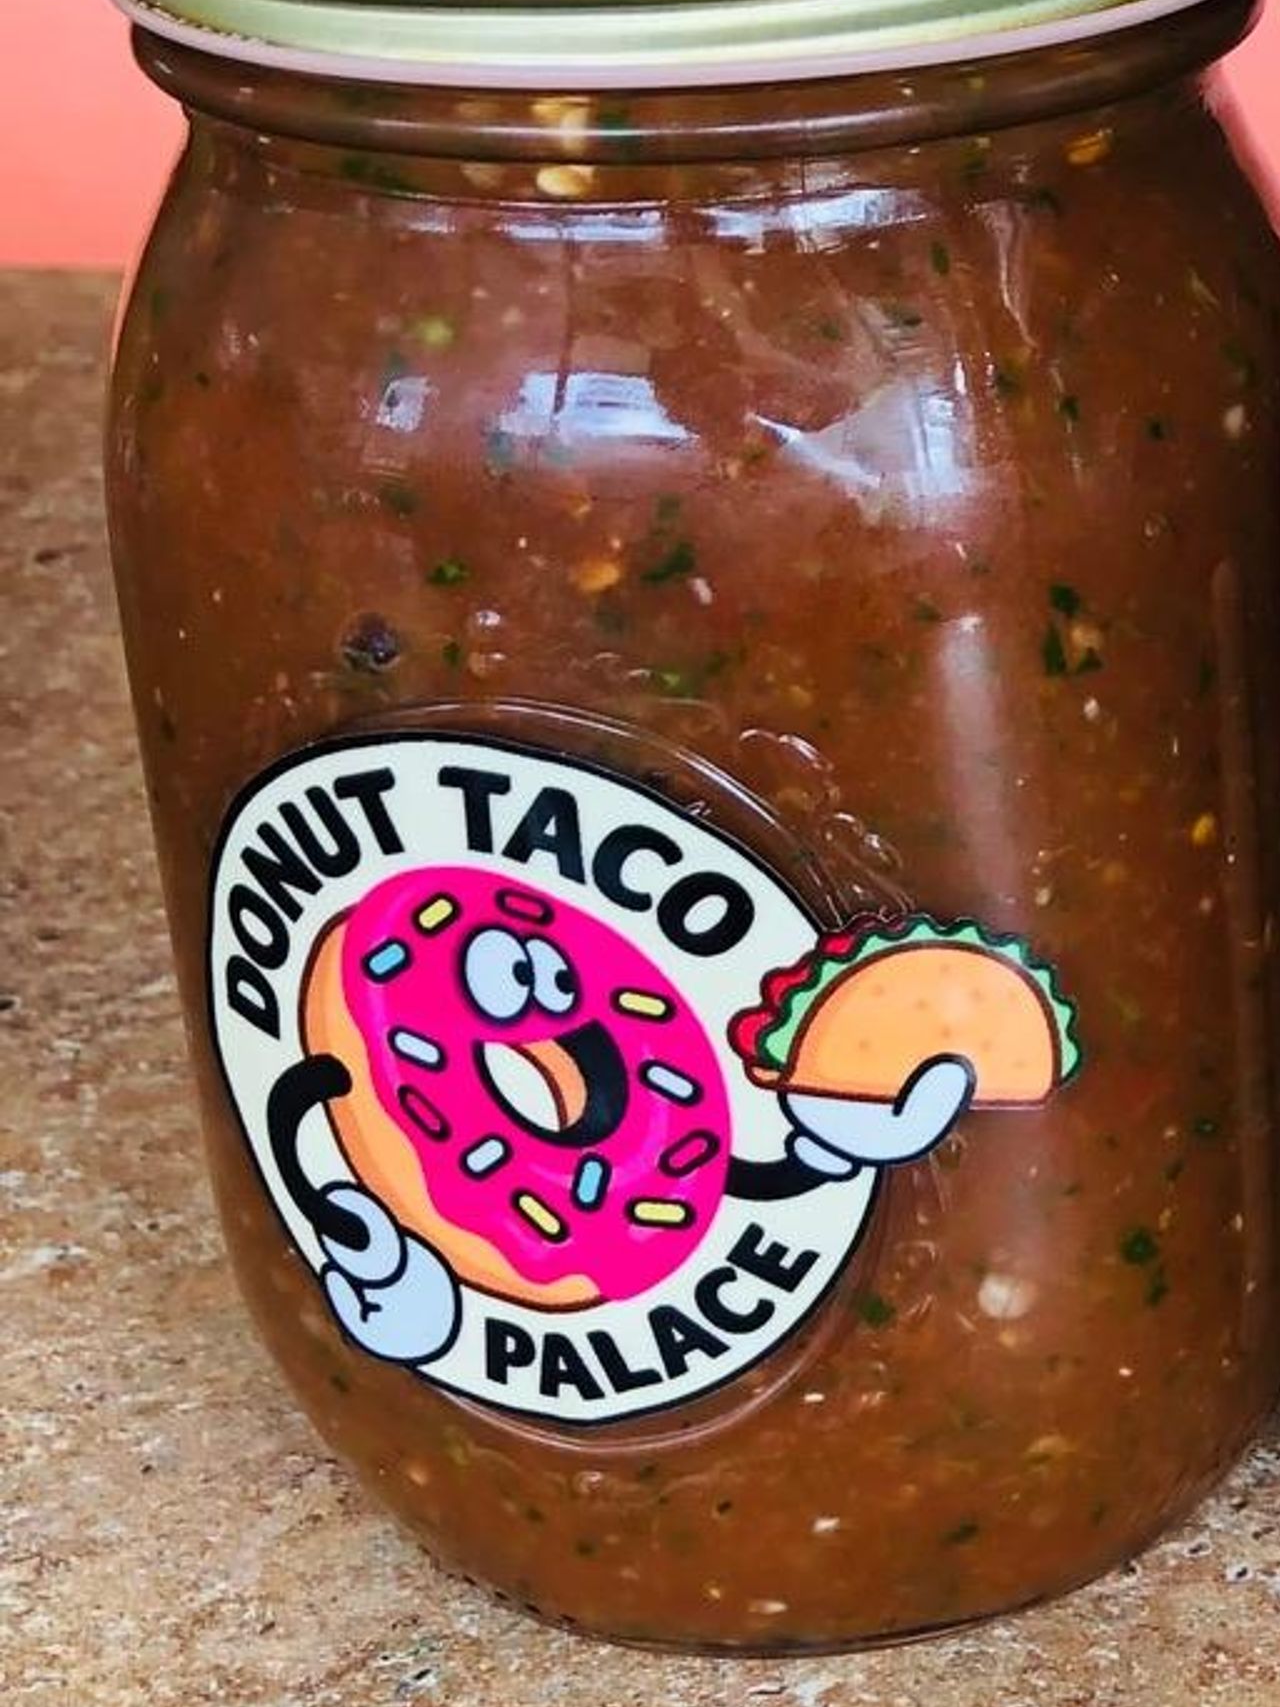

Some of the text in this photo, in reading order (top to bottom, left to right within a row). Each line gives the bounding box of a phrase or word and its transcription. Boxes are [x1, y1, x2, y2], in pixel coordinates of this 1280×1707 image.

[226, 766, 755, 1039] DONUT TACO
[484, 1224, 820, 1400] PALACE
